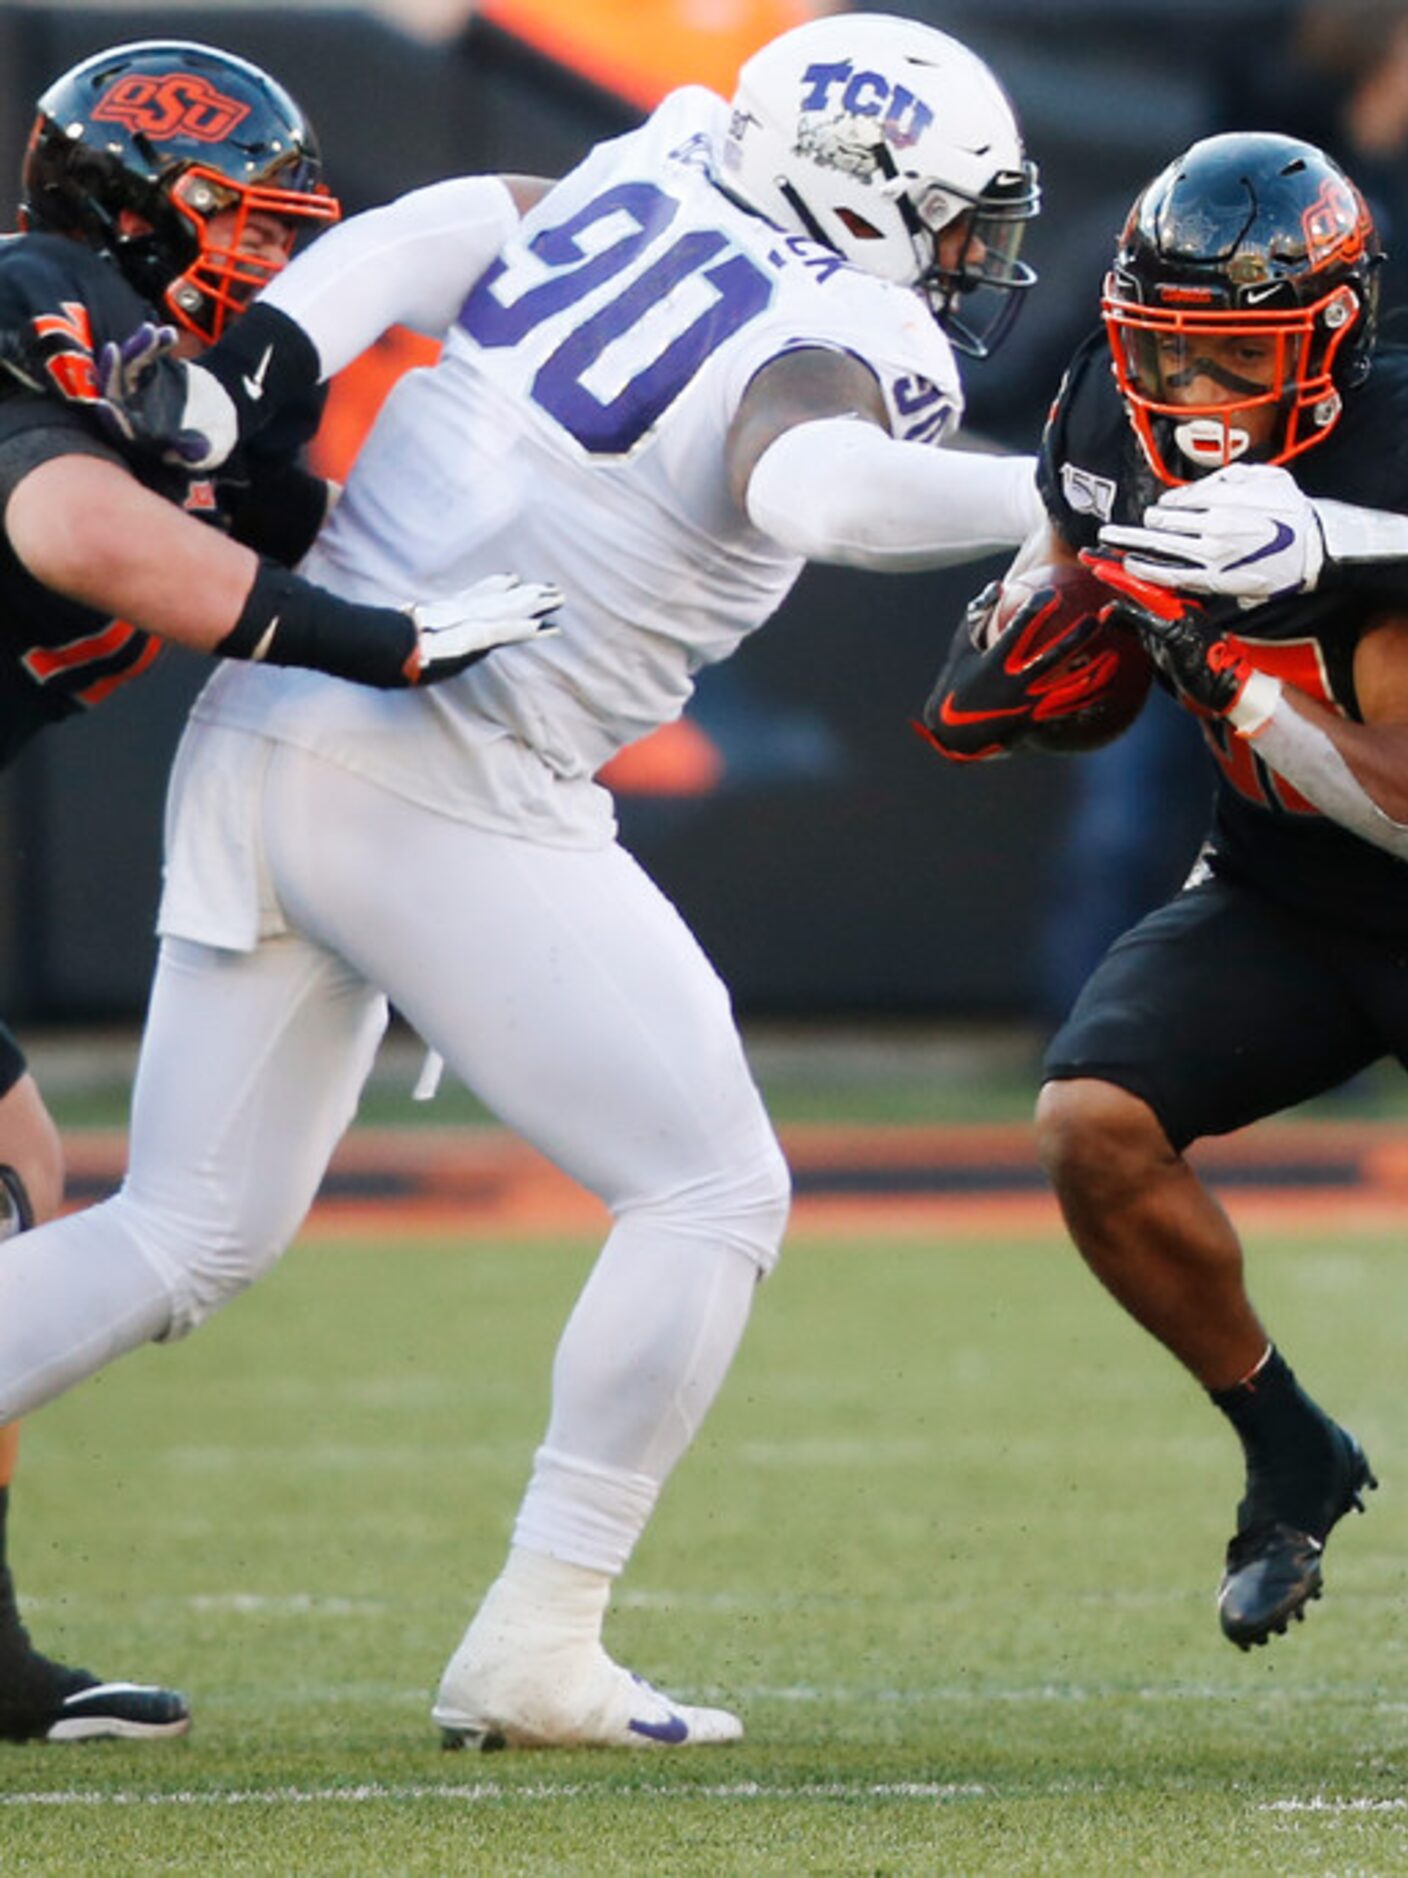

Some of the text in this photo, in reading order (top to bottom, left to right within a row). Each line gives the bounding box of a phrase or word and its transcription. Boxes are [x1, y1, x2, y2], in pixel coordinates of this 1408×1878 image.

[90, 73, 252, 144] OSU
[801, 63, 934, 150] TCU
[458, 182, 773, 453] 90
